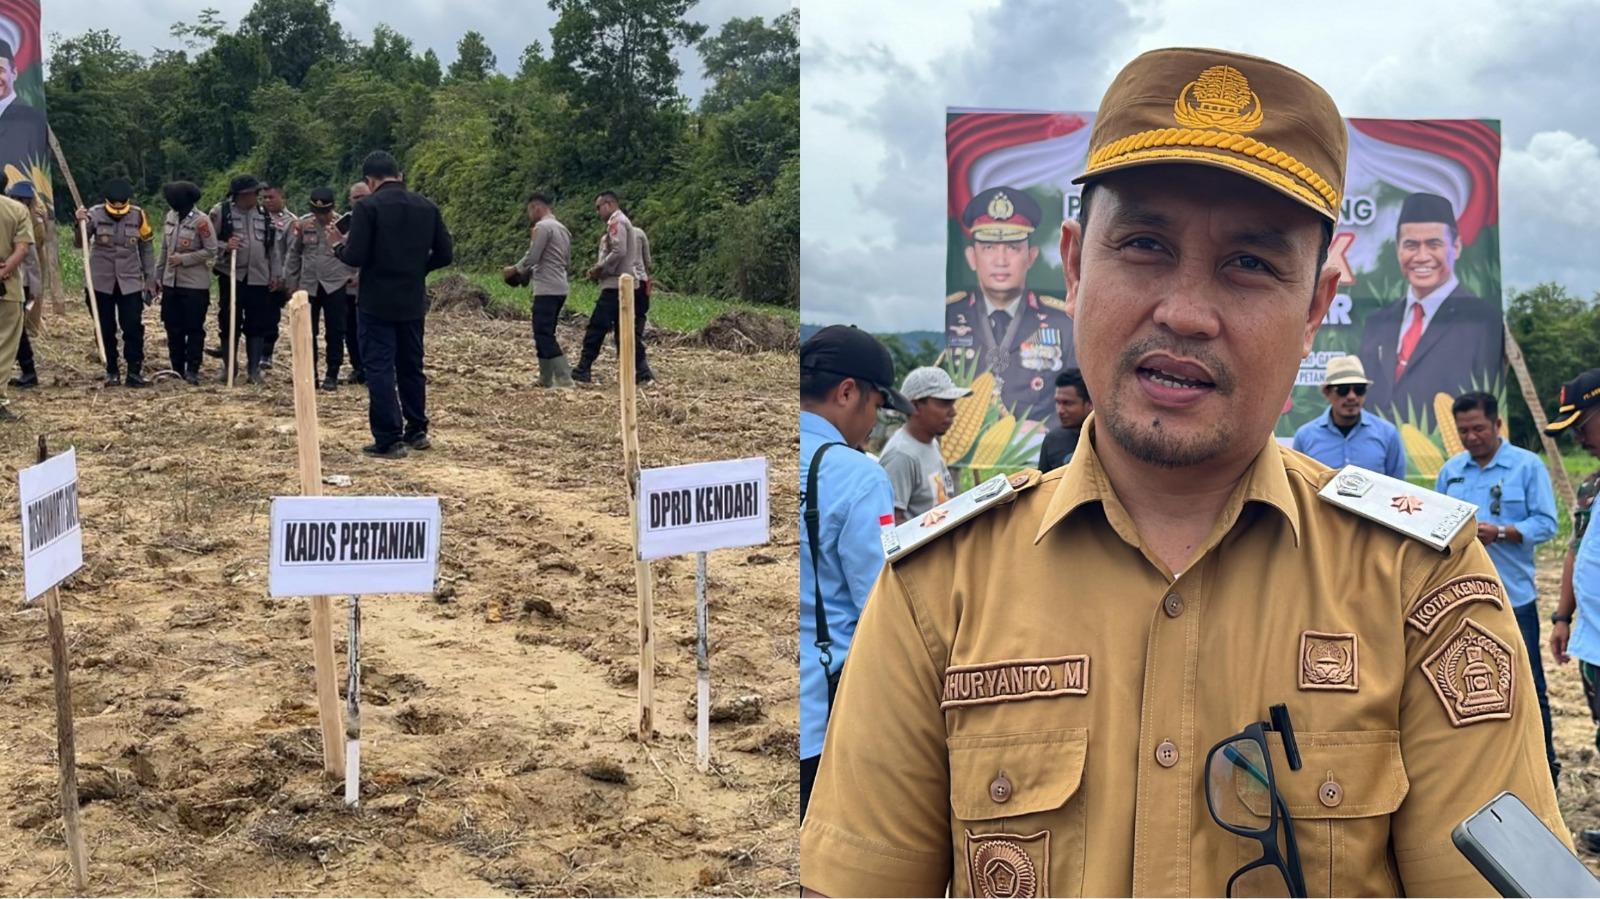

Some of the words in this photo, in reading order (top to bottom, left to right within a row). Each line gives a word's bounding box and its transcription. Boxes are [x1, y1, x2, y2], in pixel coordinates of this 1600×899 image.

[650, 489, 692, 528] DPRD
[695, 481, 758, 523] KENDARI
[284, 521, 337, 562] KADIS
[339, 521, 426, 560] PERTANIAN
[1415, 593, 1451, 624] KOTA
